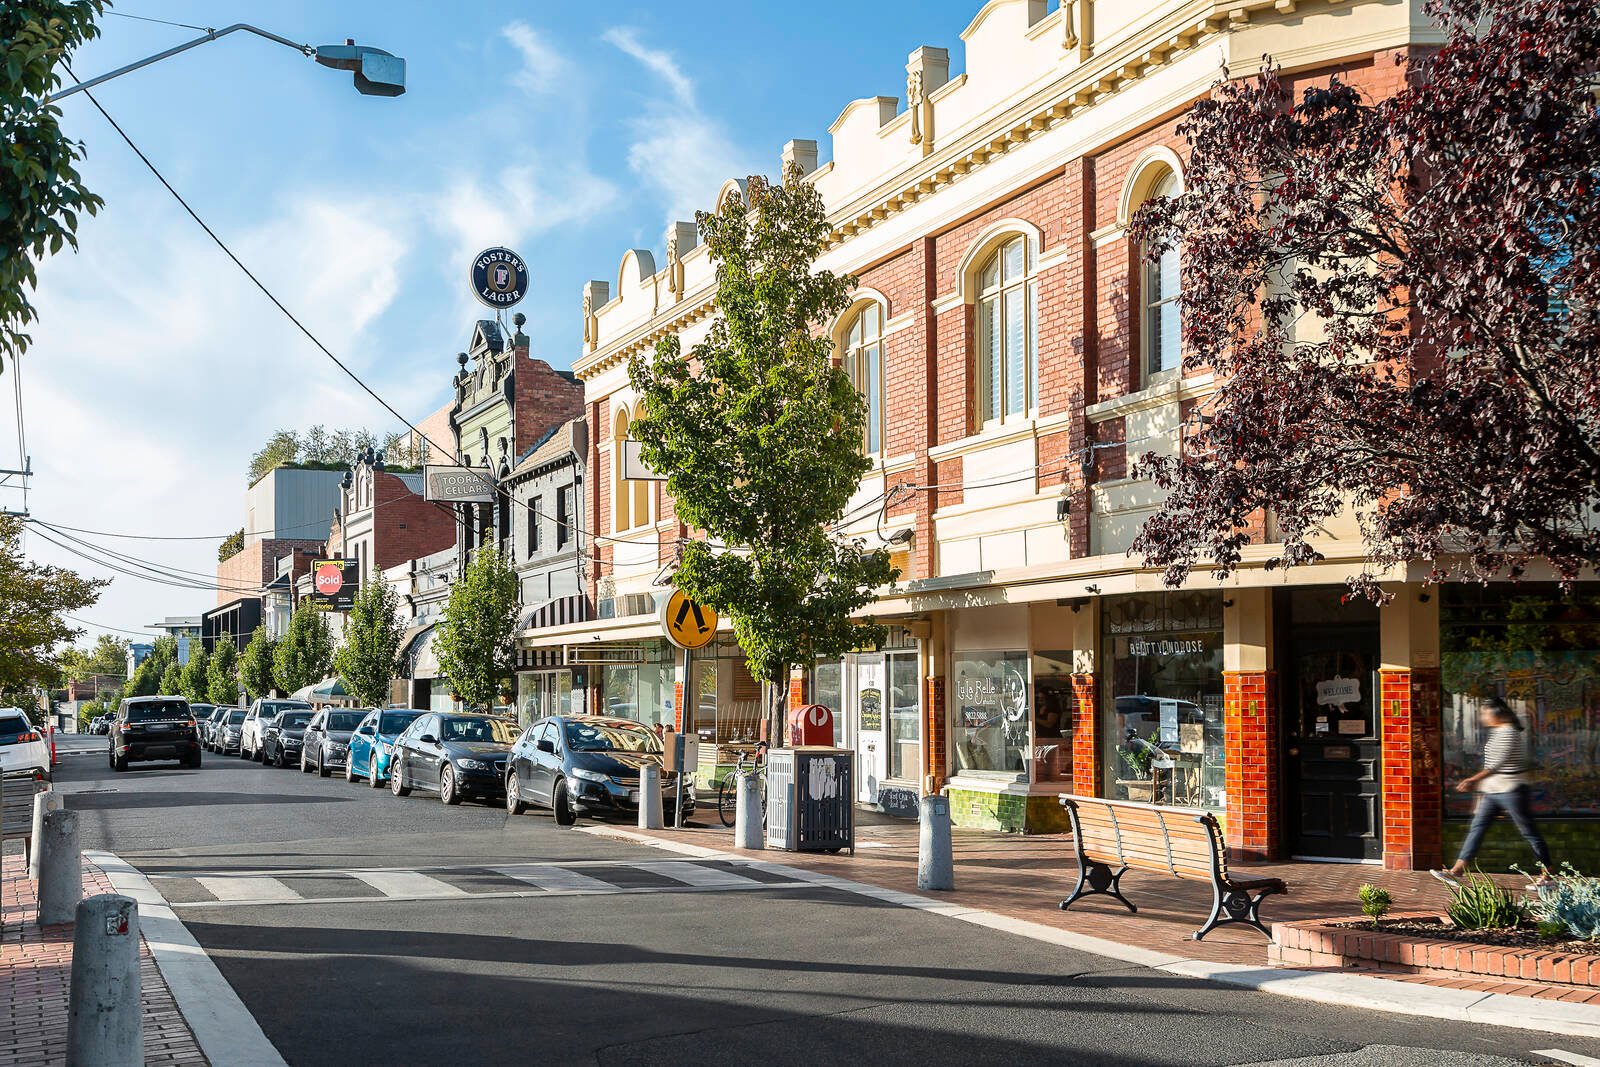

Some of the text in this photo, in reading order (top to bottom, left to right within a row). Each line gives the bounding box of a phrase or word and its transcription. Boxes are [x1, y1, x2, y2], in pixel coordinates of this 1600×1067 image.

[477, 252, 524, 272] FOSTER'S
[496, 269, 508, 284] F
[482, 287, 520, 302] LAGER
[445, 484, 489, 495] CELLARS
[319, 575, 340, 585] Sold
[974, 678, 996, 705] Belle
